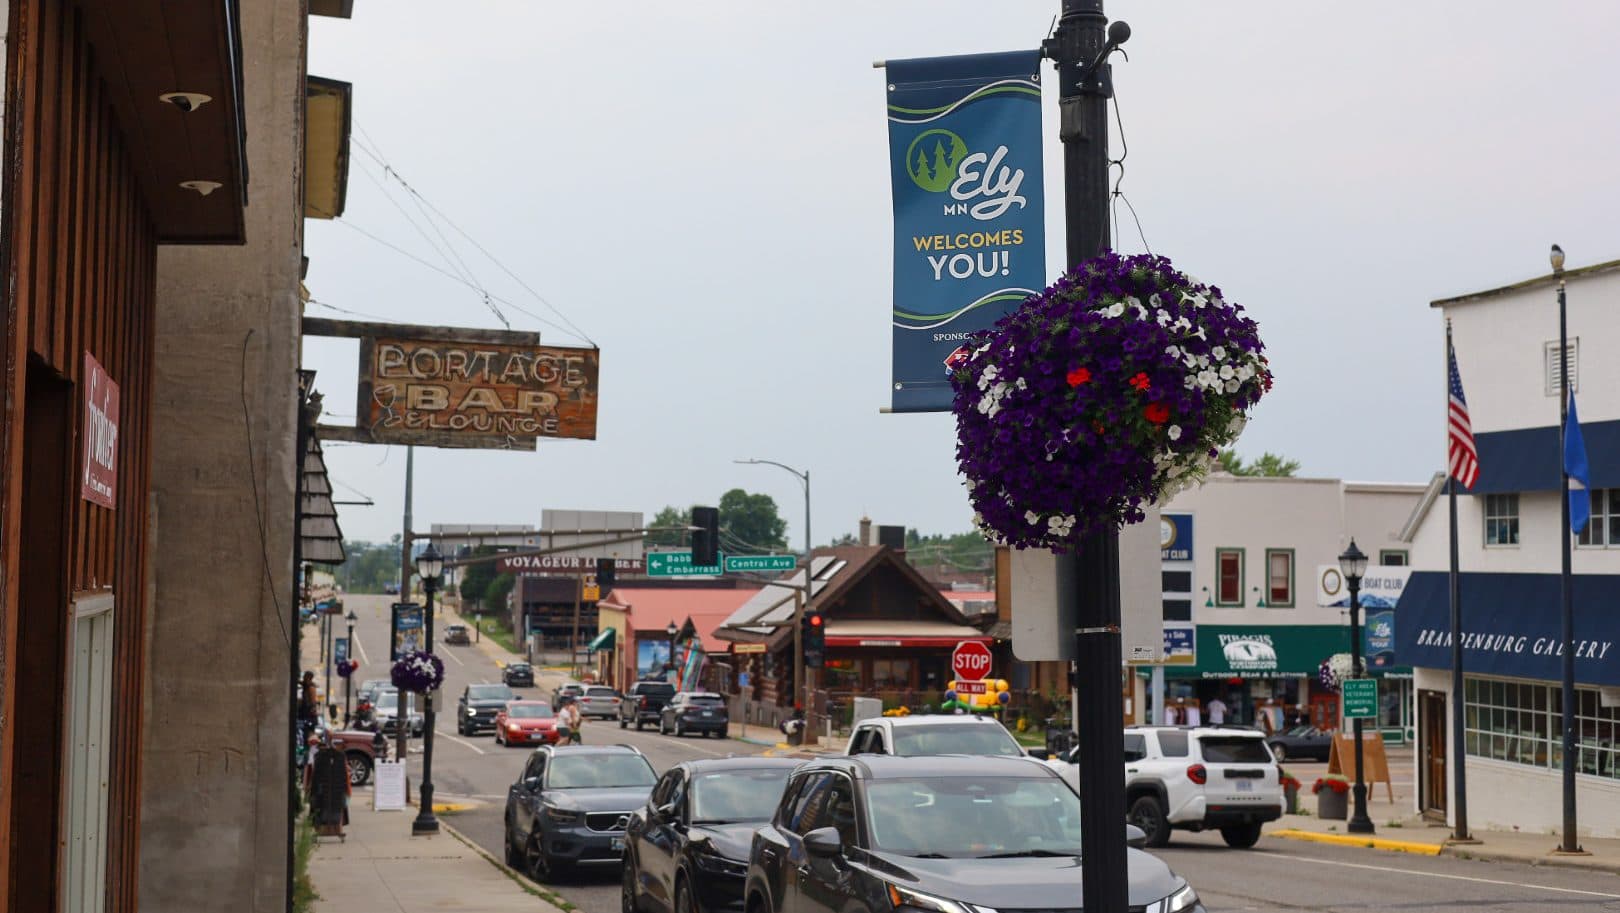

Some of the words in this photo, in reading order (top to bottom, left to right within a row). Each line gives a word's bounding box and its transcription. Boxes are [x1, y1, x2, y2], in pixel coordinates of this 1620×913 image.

[950, 145, 1027, 221] Ely
[943, 203, 968, 216] MN
[913, 229, 1024, 252] WELCOMES
[927, 250, 1010, 281] YOU!
[933, 332, 971, 342] SPONSO
[378, 344, 586, 385] PORTAGE
[407, 384, 560, 416] BAR
[428, 411, 559, 434] LOUNGE
[504, 556, 580, 568] VOYAGEUR
[585, 558, 641, 569] LUBER
[666, 554, 692, 562] Babb
[731, 559, 768, 568] Central
[772, 559, 791, 567] Ave
[666, 565, 719, 574] Embarrass
[1364, 577, 1382, 589] BOAT
[1384, 578, 1403, 590] CLUB
[1217, 633, 1274, 648] PIRAGIS
[1533, 637, 1612, 660] GALERY
[955, 653, 990, 670] STOP
[956, 682, 969, 692] ALL
[971, 684, 986, 693] WAY
